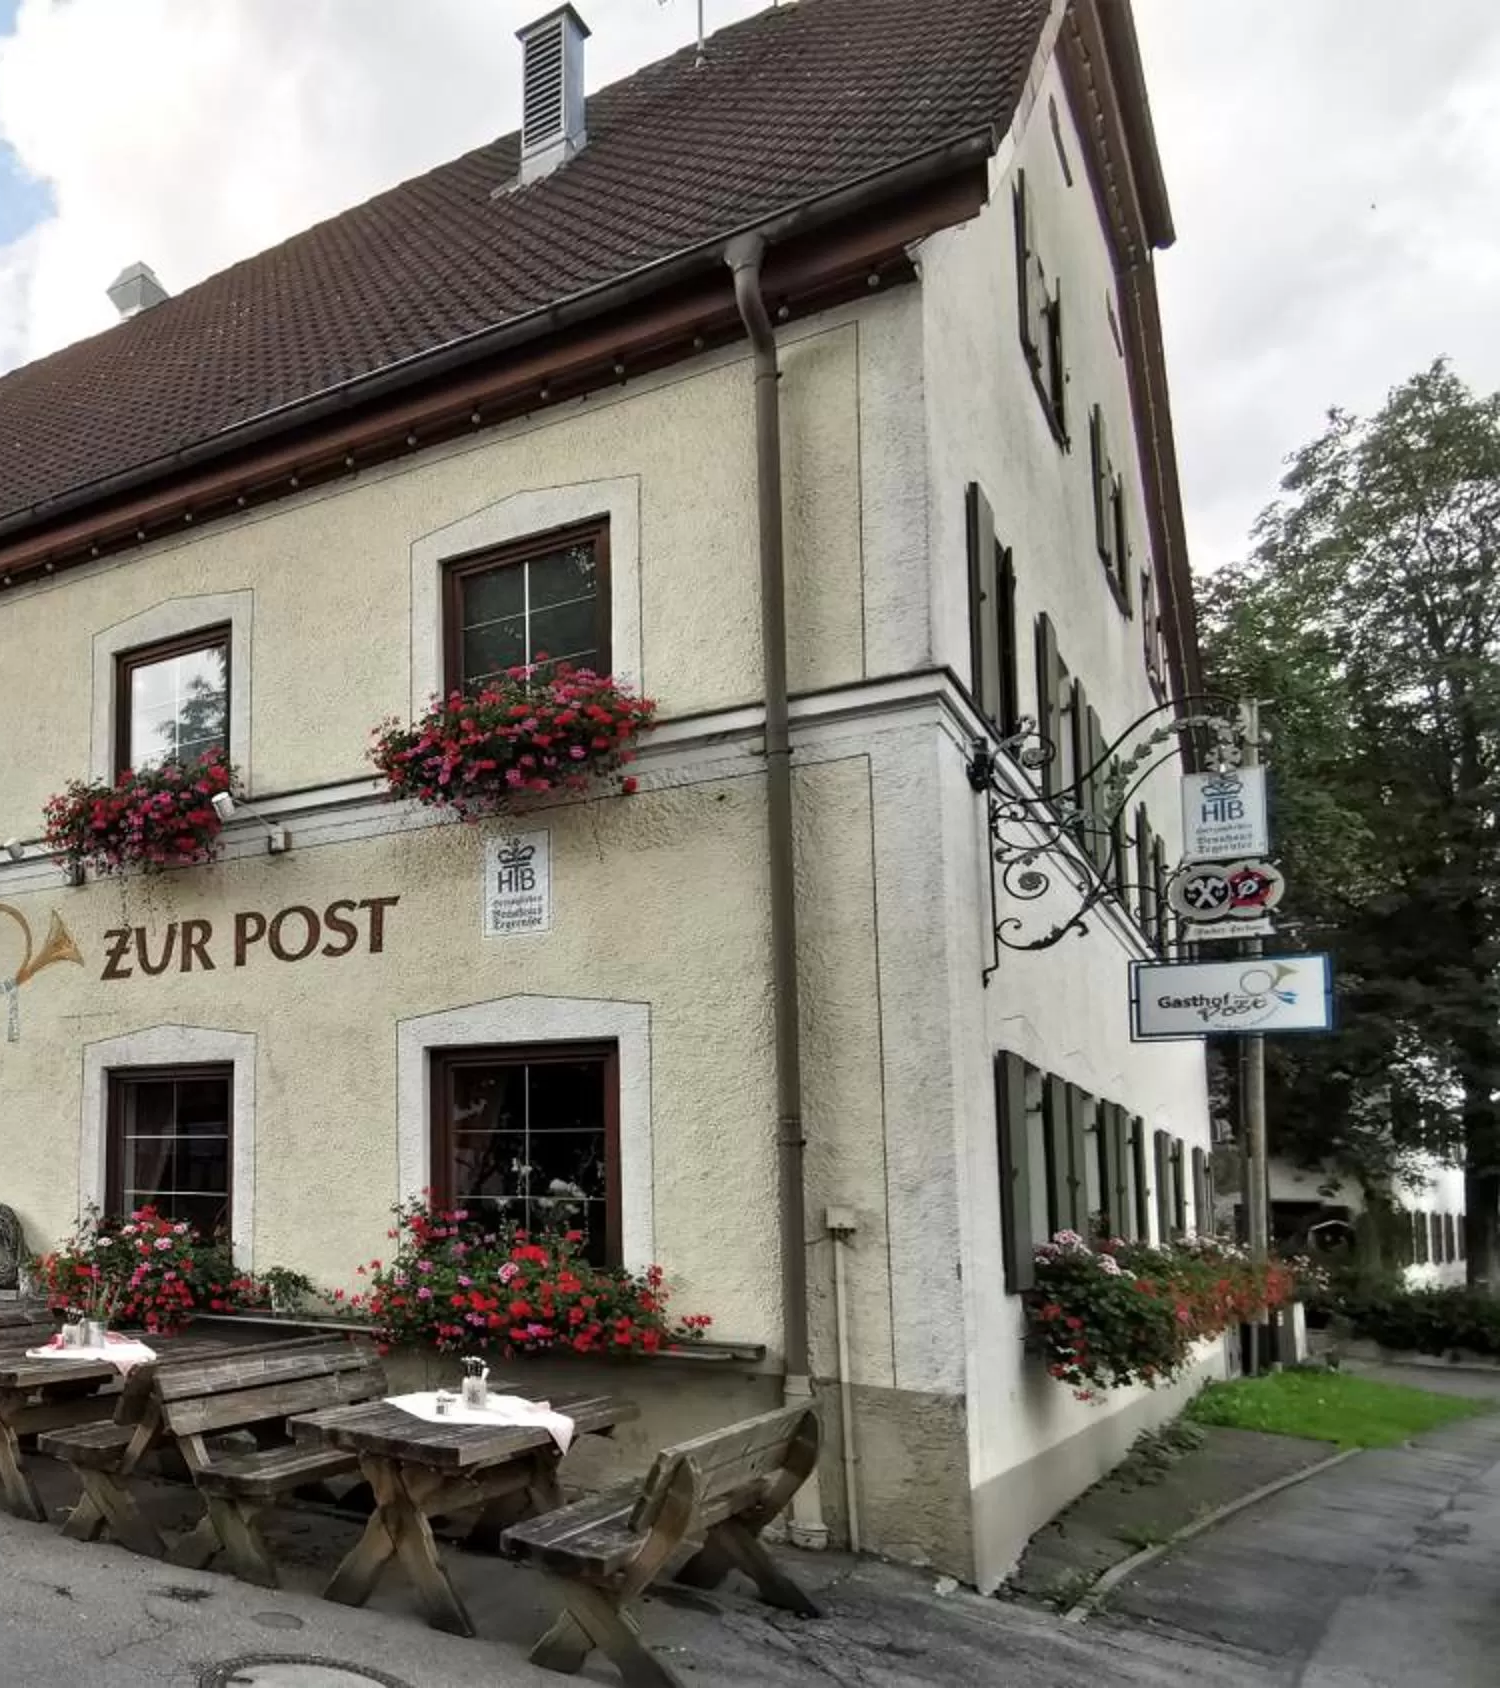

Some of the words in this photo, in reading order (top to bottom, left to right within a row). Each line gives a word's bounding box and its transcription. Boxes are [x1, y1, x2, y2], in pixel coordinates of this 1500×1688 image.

[1201, 797, 1245, 823] HTB
[497, 863, 536, 893] HTB
[100, 918, 216, 981] ZUR
[234, 895, 400, 967] POST
[1157, 992, 1230, 1009] Gasthof
